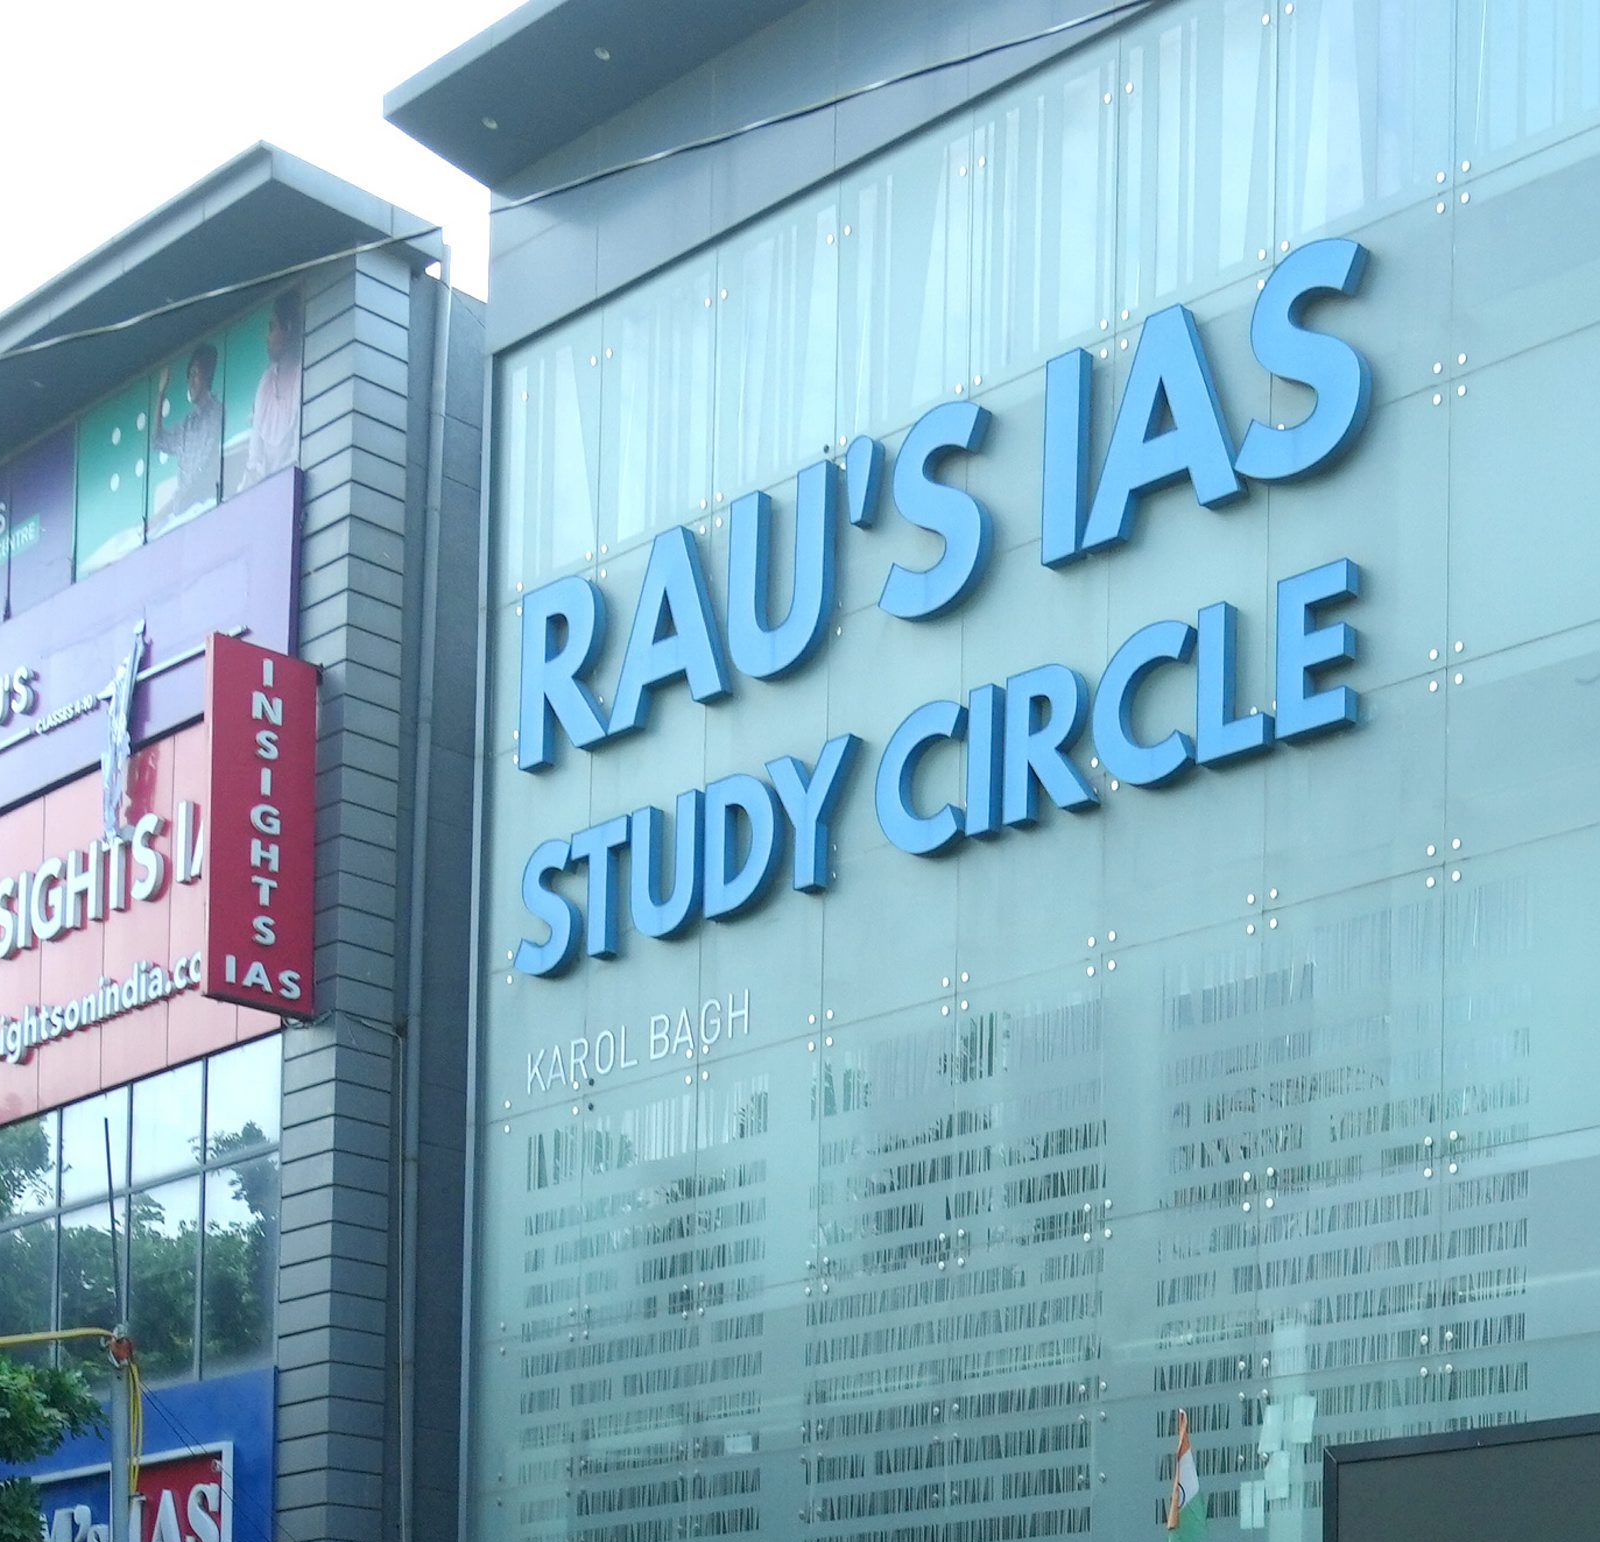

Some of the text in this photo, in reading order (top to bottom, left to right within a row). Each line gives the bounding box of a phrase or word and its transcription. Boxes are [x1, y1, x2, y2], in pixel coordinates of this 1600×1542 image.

[516, 237, 1372, 774] RAU'S IAS
[250, 657, 285, 948] INSIGHTS
[513, 557, 1358, 979] STUDY CIRCLE
[224, 954, 302, 1002] IAS
[526, 987, 751, 1095] KAROL BAGH
